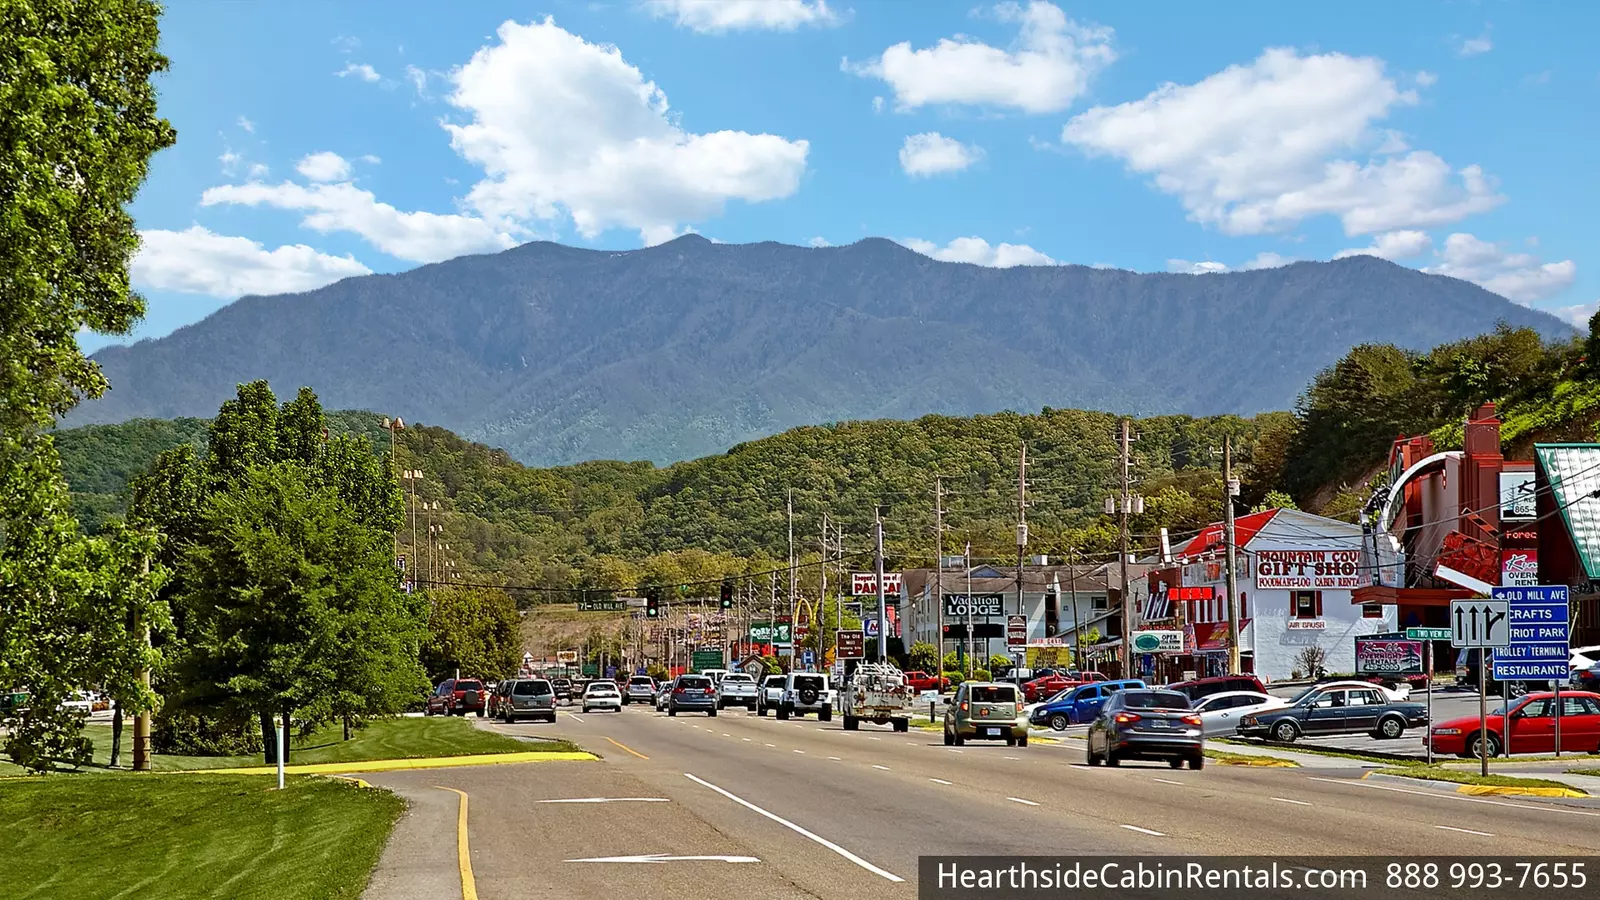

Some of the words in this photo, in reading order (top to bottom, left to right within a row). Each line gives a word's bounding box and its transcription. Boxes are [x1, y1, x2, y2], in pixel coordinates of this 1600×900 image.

[1260, 551, 1325, 562] MOUNTAIN
[1332, 551, 1360, 562] COU
[1259, 563, 1307, 576] GIFT
[1314, 563, 1359, 576] SHO
[1315, 577, 1335, 587] CABIN
[949, 595, 999, 605] Vacation
[1507, 591, 1522, 600] OLD
[1527, 591, 1545, 600] MILL
[1550, 590, 1565, 600] AVE
[947, 605, 1001, 615] LODGE
[1509, 609, 1552, 619] CRAFTS
[1417, 630, 1428, 638] TWO
[1510, 628, 1535, 638] TRIOT
[1539, 628, 1565, 638] PARK
[1496, 647, 1526, 657] TROLLEY
[1531, 646, 1566, 656] TERMINAL
[1497, 665, 1567, 676] RESTAURANTS
